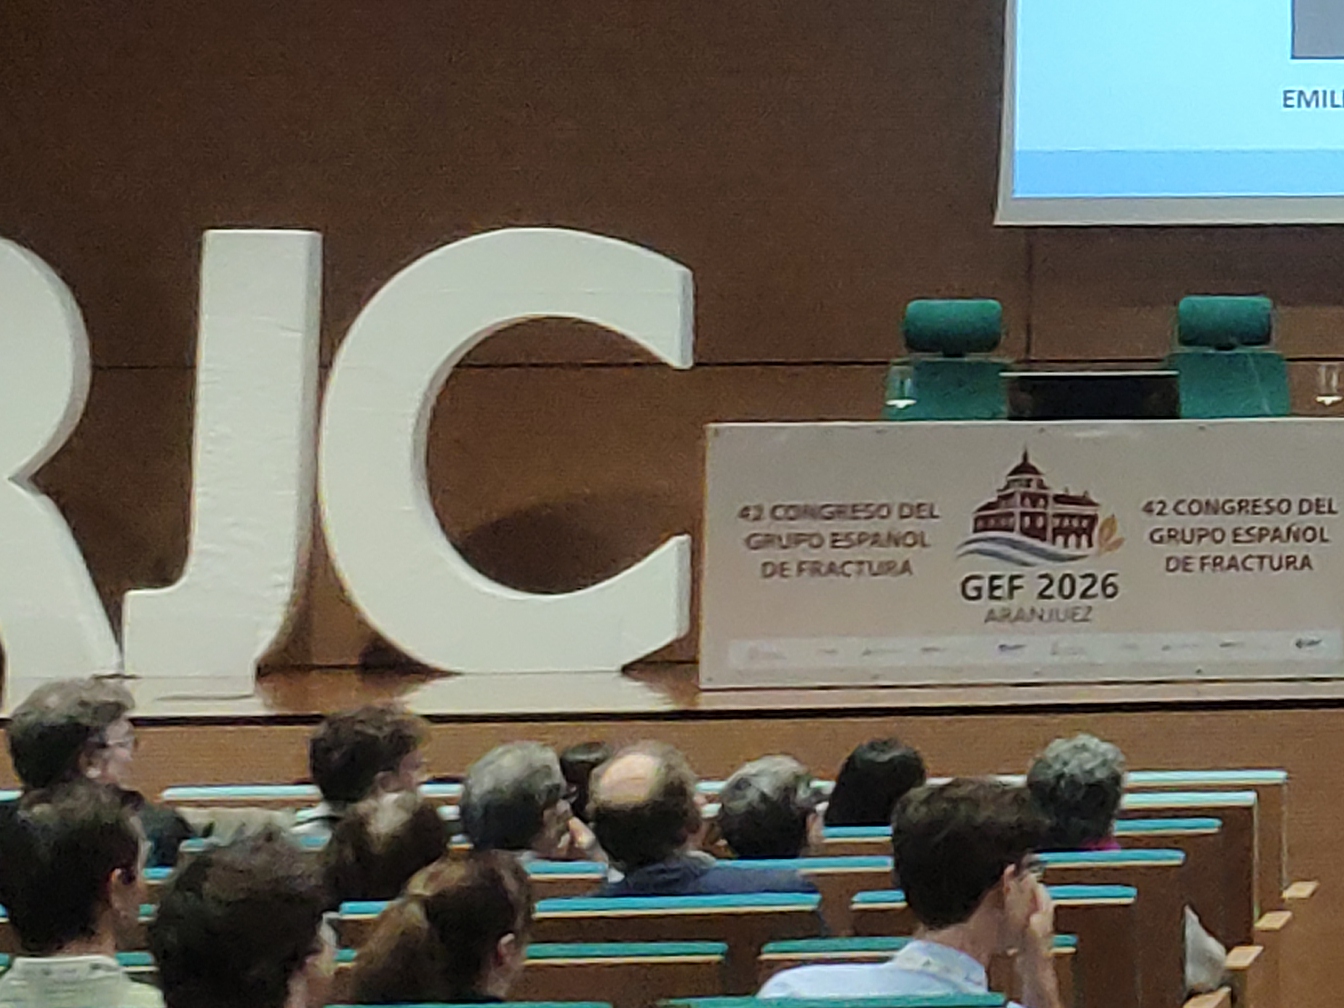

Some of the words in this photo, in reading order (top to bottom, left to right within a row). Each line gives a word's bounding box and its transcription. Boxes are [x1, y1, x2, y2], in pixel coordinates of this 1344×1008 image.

[738, 504, 763, 523] 42
[770, 502, 893, 522] CONGRESO
[900, 501, 940, 521] DEL
[1142, 498, 1167, 517] 42
[1174, 497, 1292, 517] CONGRESO
[1299, 497, 1338, 516] DEL
[745, 533, 824, 552] GRUPO
[830, 528, 931, 550] ESPAÑOL
[1149, 526, 1226, 546] GRUPO
[1232, 521, 1330, 545] ESPAÑOL
[761, 560, 792, 579] DE
[796, 559, 914, 579] FRACTURA
[1165, 555, 1196, 573] DE
[1199, 554, 1313, 573] FRACTURA
[960, 574, 1024, 603] GEF
[1037, 571, 1120, 601] 2026
[983, 605, 1094, 625] ARANJUEZ
